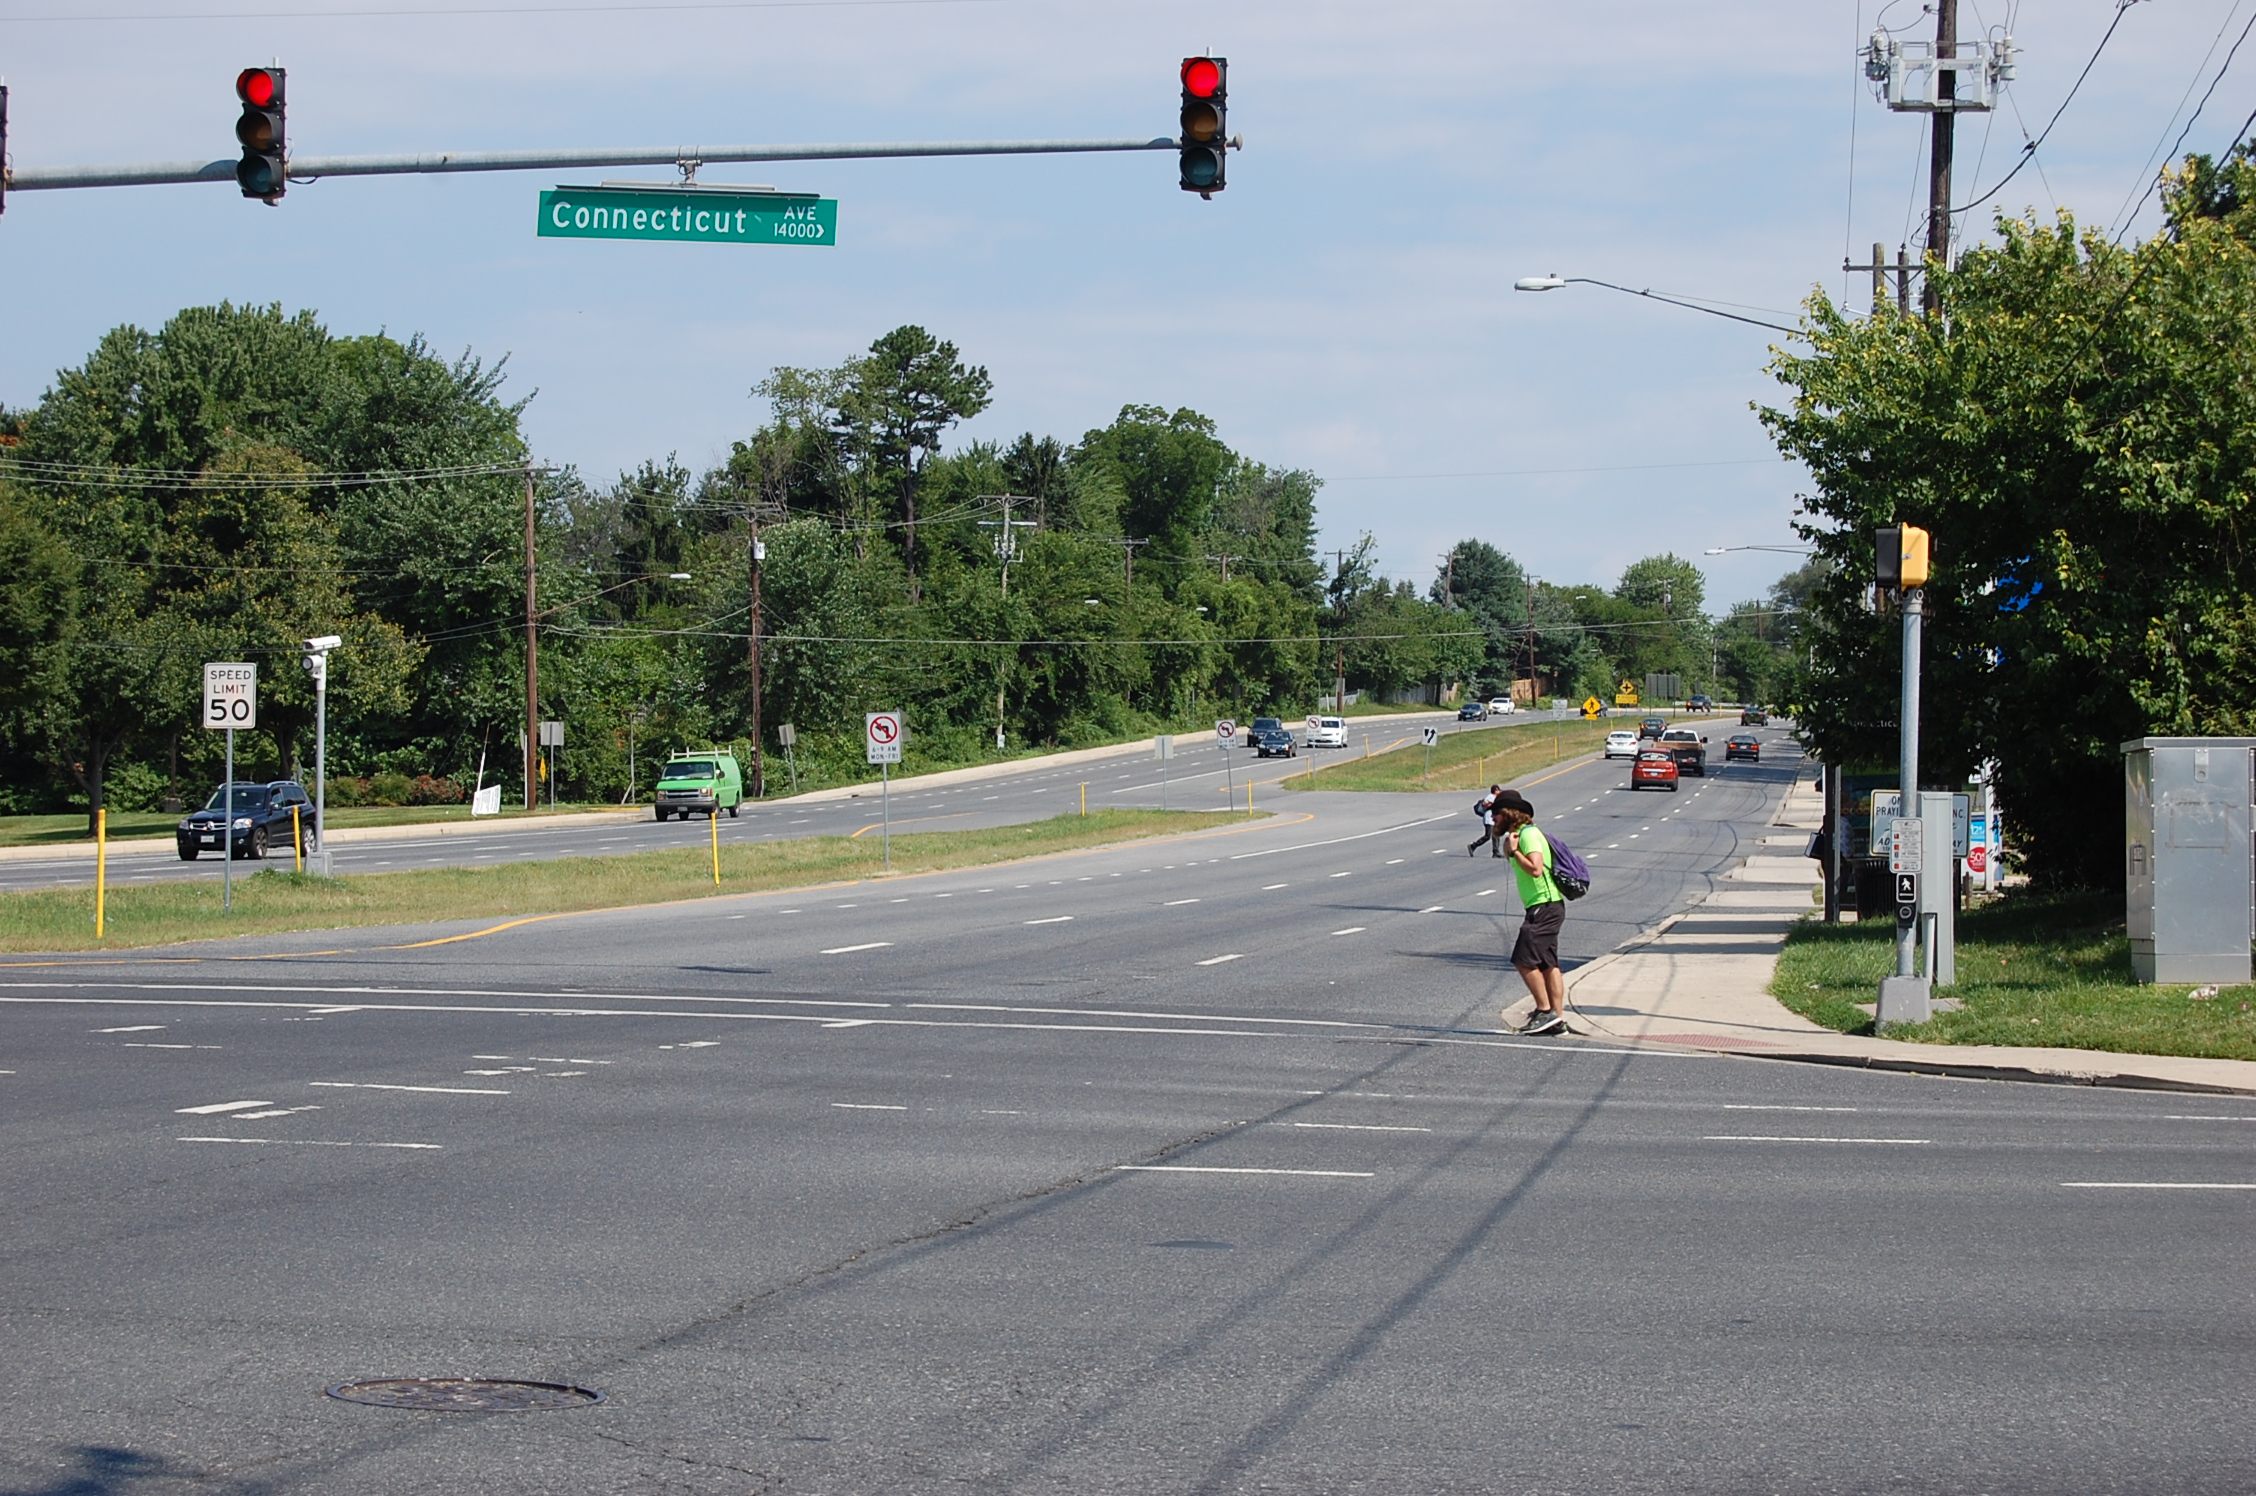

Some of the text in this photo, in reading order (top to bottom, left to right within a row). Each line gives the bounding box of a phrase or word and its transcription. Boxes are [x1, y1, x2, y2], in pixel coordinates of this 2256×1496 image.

[552, 201, 747, 233] Connecticut
[783, 205, 817, 221] AVE
[773, 222, 816, 239] 14000
[210, 670, 252, 680] SPEED
[213, 684, 247, 694] LIMIT
[210, 698, 250, 721] 50
[1875, 806, 1899, 816] PRAYI
[1952, 808, 1966, 820] NC.
